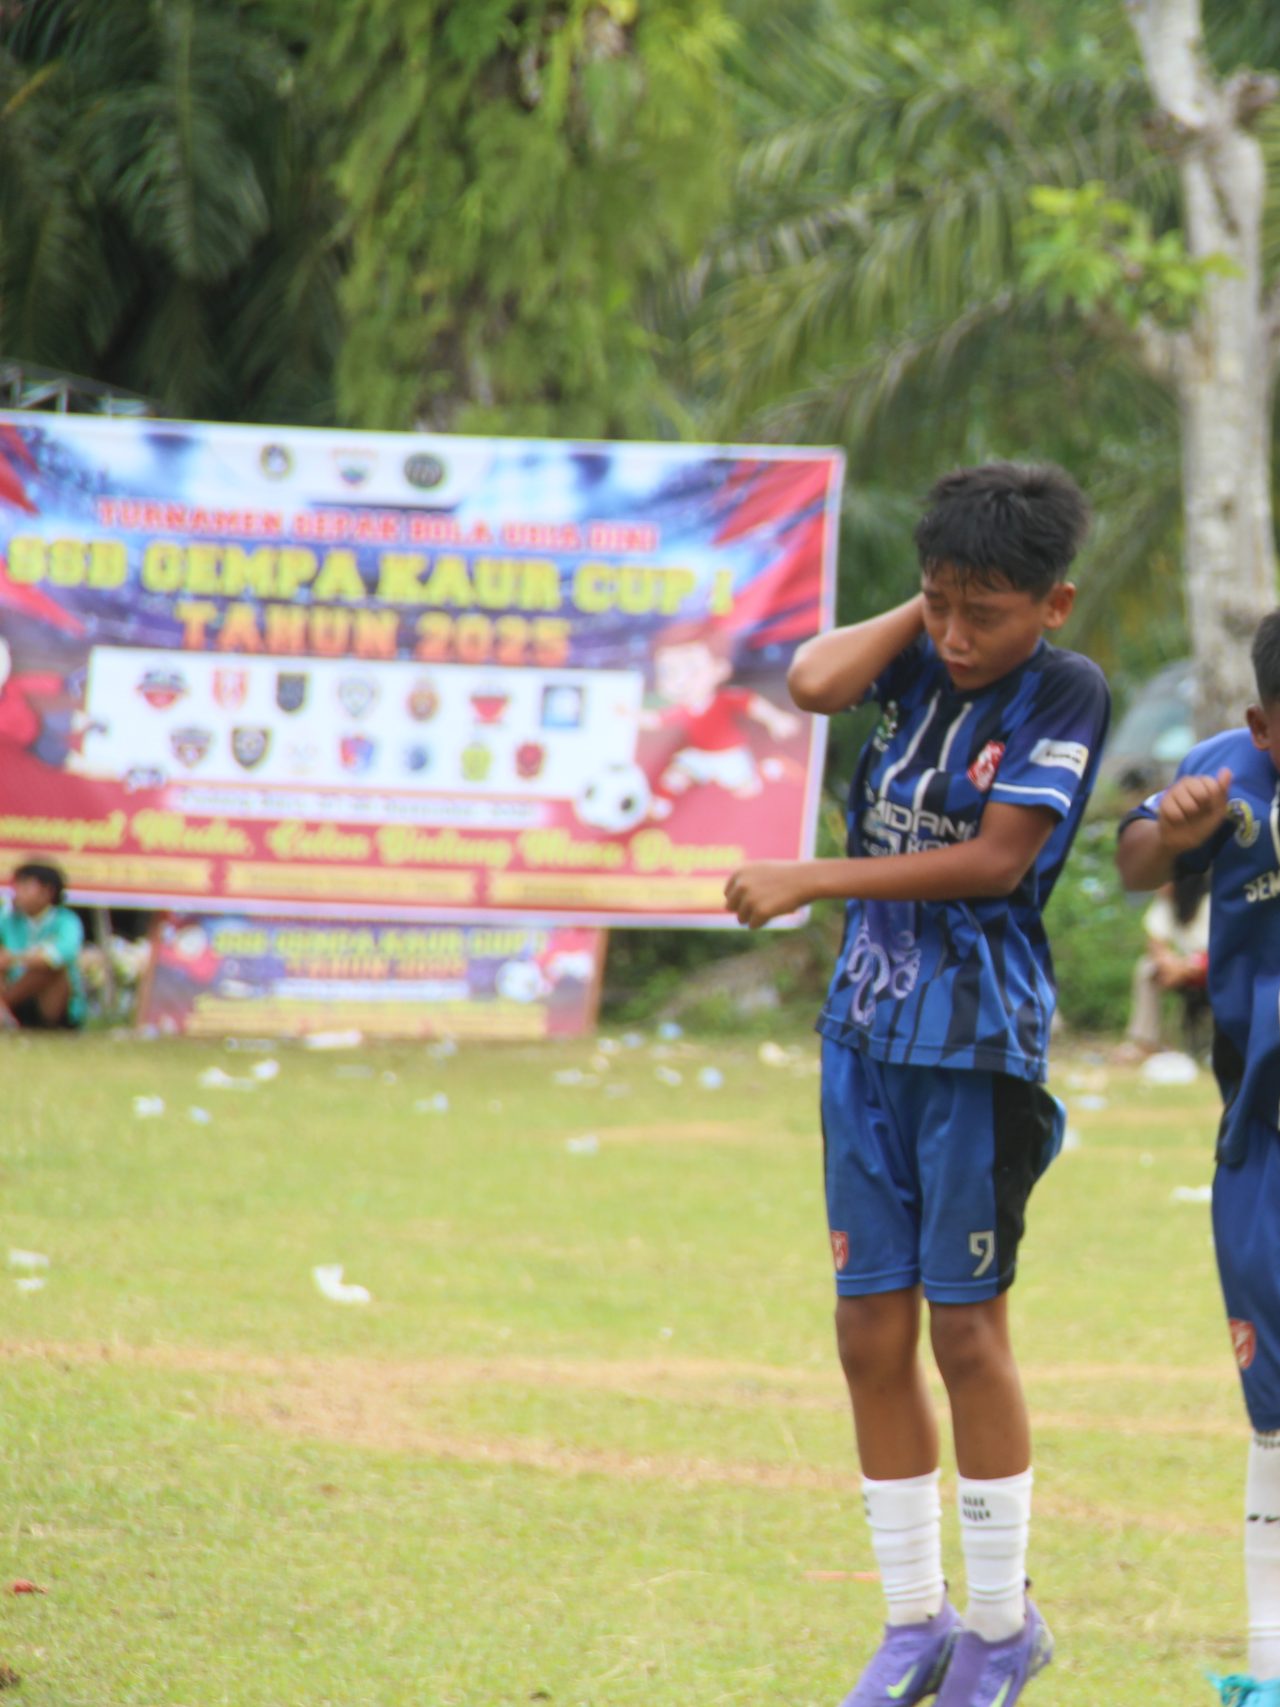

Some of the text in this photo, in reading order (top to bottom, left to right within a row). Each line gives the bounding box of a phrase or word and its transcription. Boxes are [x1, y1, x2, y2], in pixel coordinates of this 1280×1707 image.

[99, 500, 283, 536] TURNAMEN
[376, 551, 562, 612] KAUR
[572, 560, 696, 616] CUP
[173, 600, 571, 669] TAHUN 2025
[969, 1230, 995, 1278] 9
